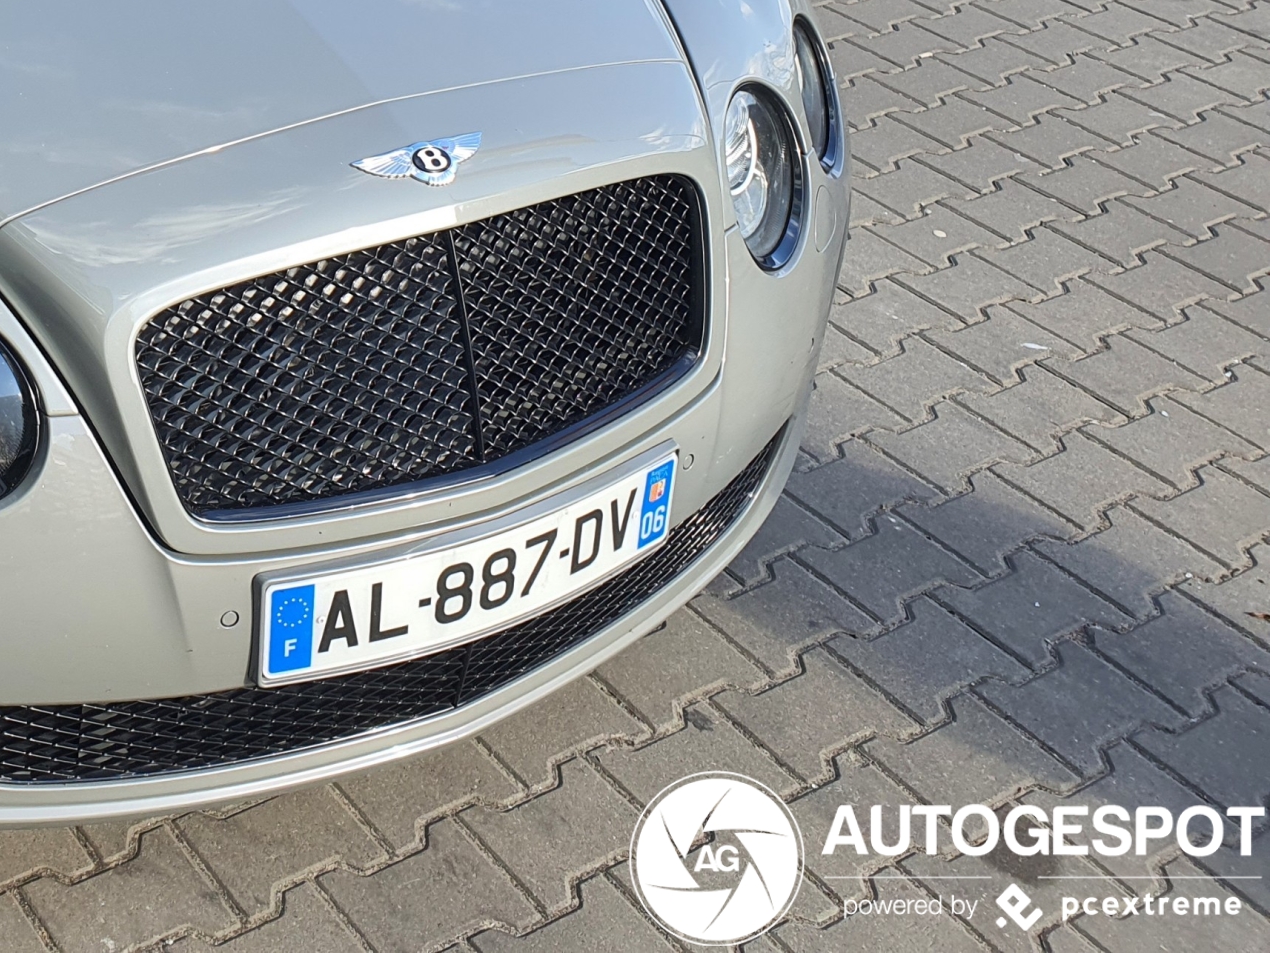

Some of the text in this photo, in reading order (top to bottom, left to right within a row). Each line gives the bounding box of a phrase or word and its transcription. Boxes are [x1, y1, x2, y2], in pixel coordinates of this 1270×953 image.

[640, 504, 666, 540] 06
[317, 487, 638, 654] AL-887-DV
[283, 637, 298, 658] F
